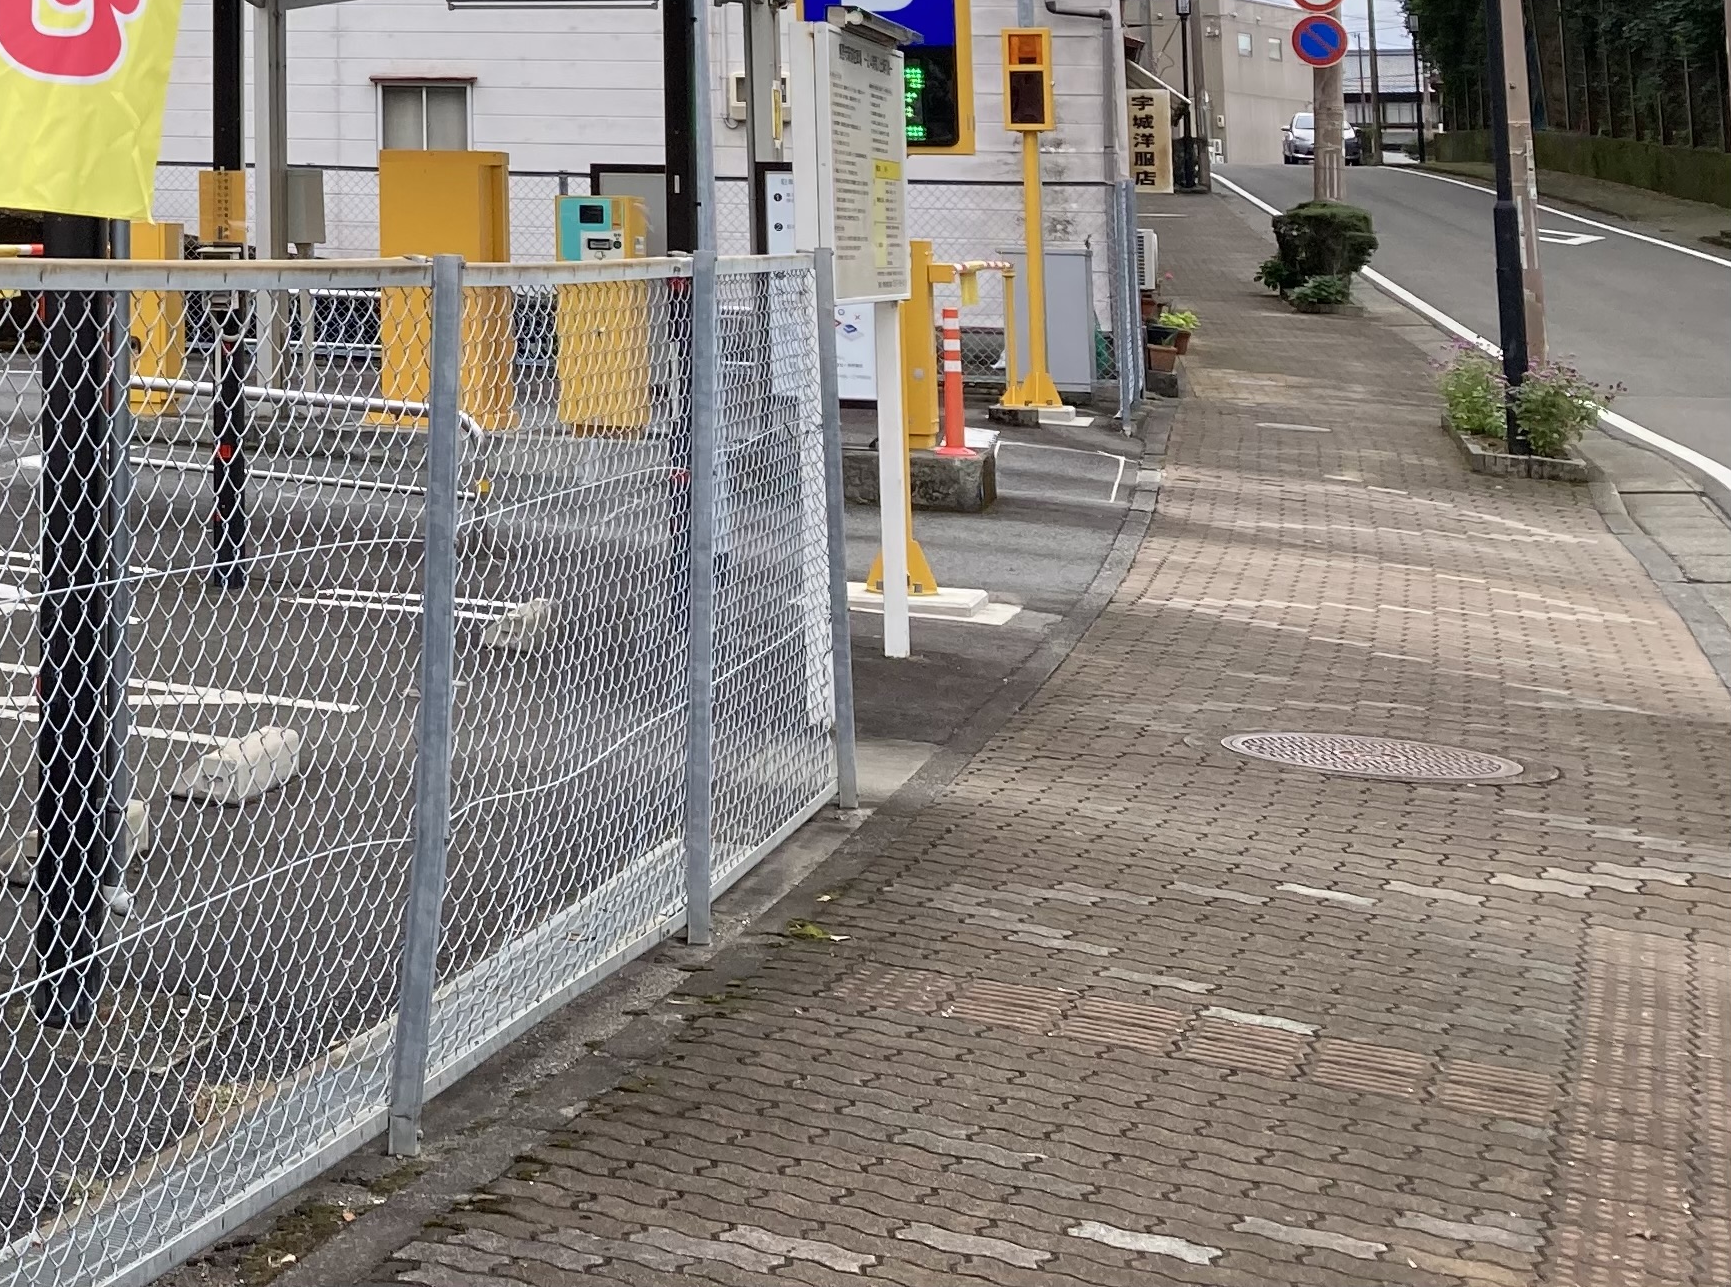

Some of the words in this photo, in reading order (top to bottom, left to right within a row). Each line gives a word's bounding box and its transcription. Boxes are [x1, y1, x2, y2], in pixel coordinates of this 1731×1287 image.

[1131, 95, 1156, 186] 宇城洋服店
